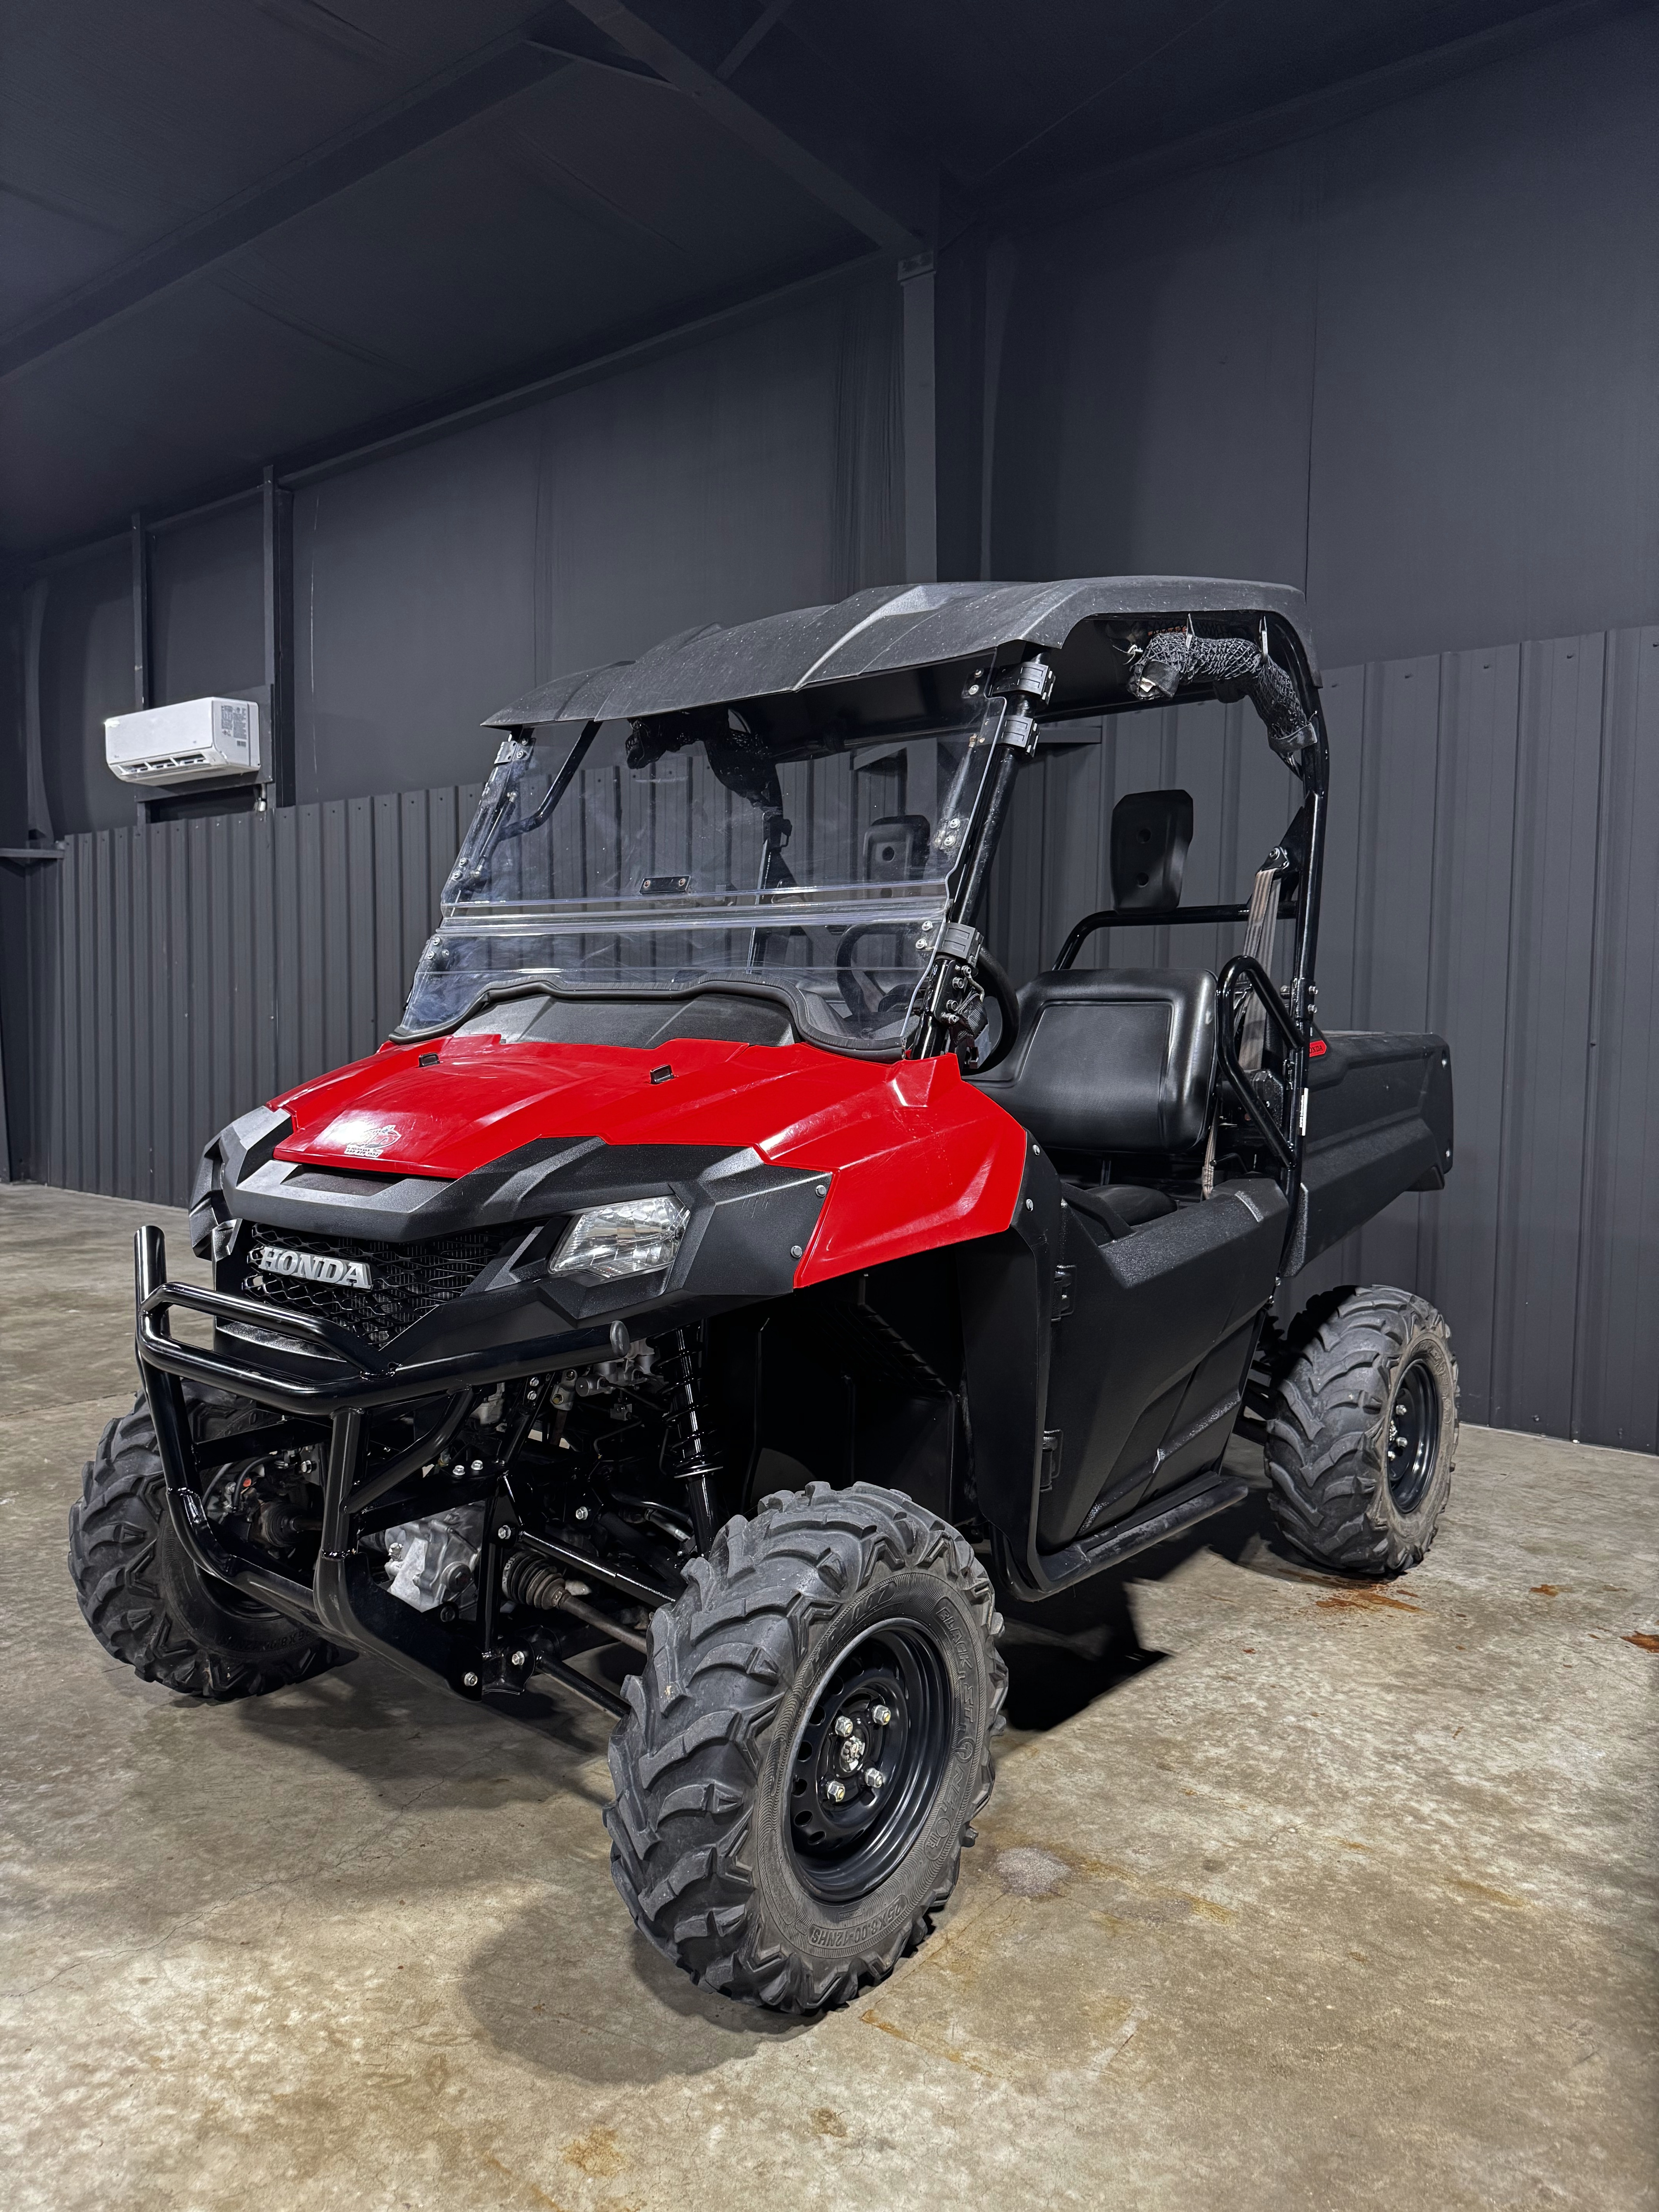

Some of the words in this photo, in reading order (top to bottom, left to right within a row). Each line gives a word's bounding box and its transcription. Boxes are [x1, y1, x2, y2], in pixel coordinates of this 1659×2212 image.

[1309, 1045, 1323, 1053] ONDA
[258, 1246, 373, 1290] HONDA
[936, 1607, 972, 1668] BLACK
[811, 1898, 902, 1947] 25X8.00-12NHS
